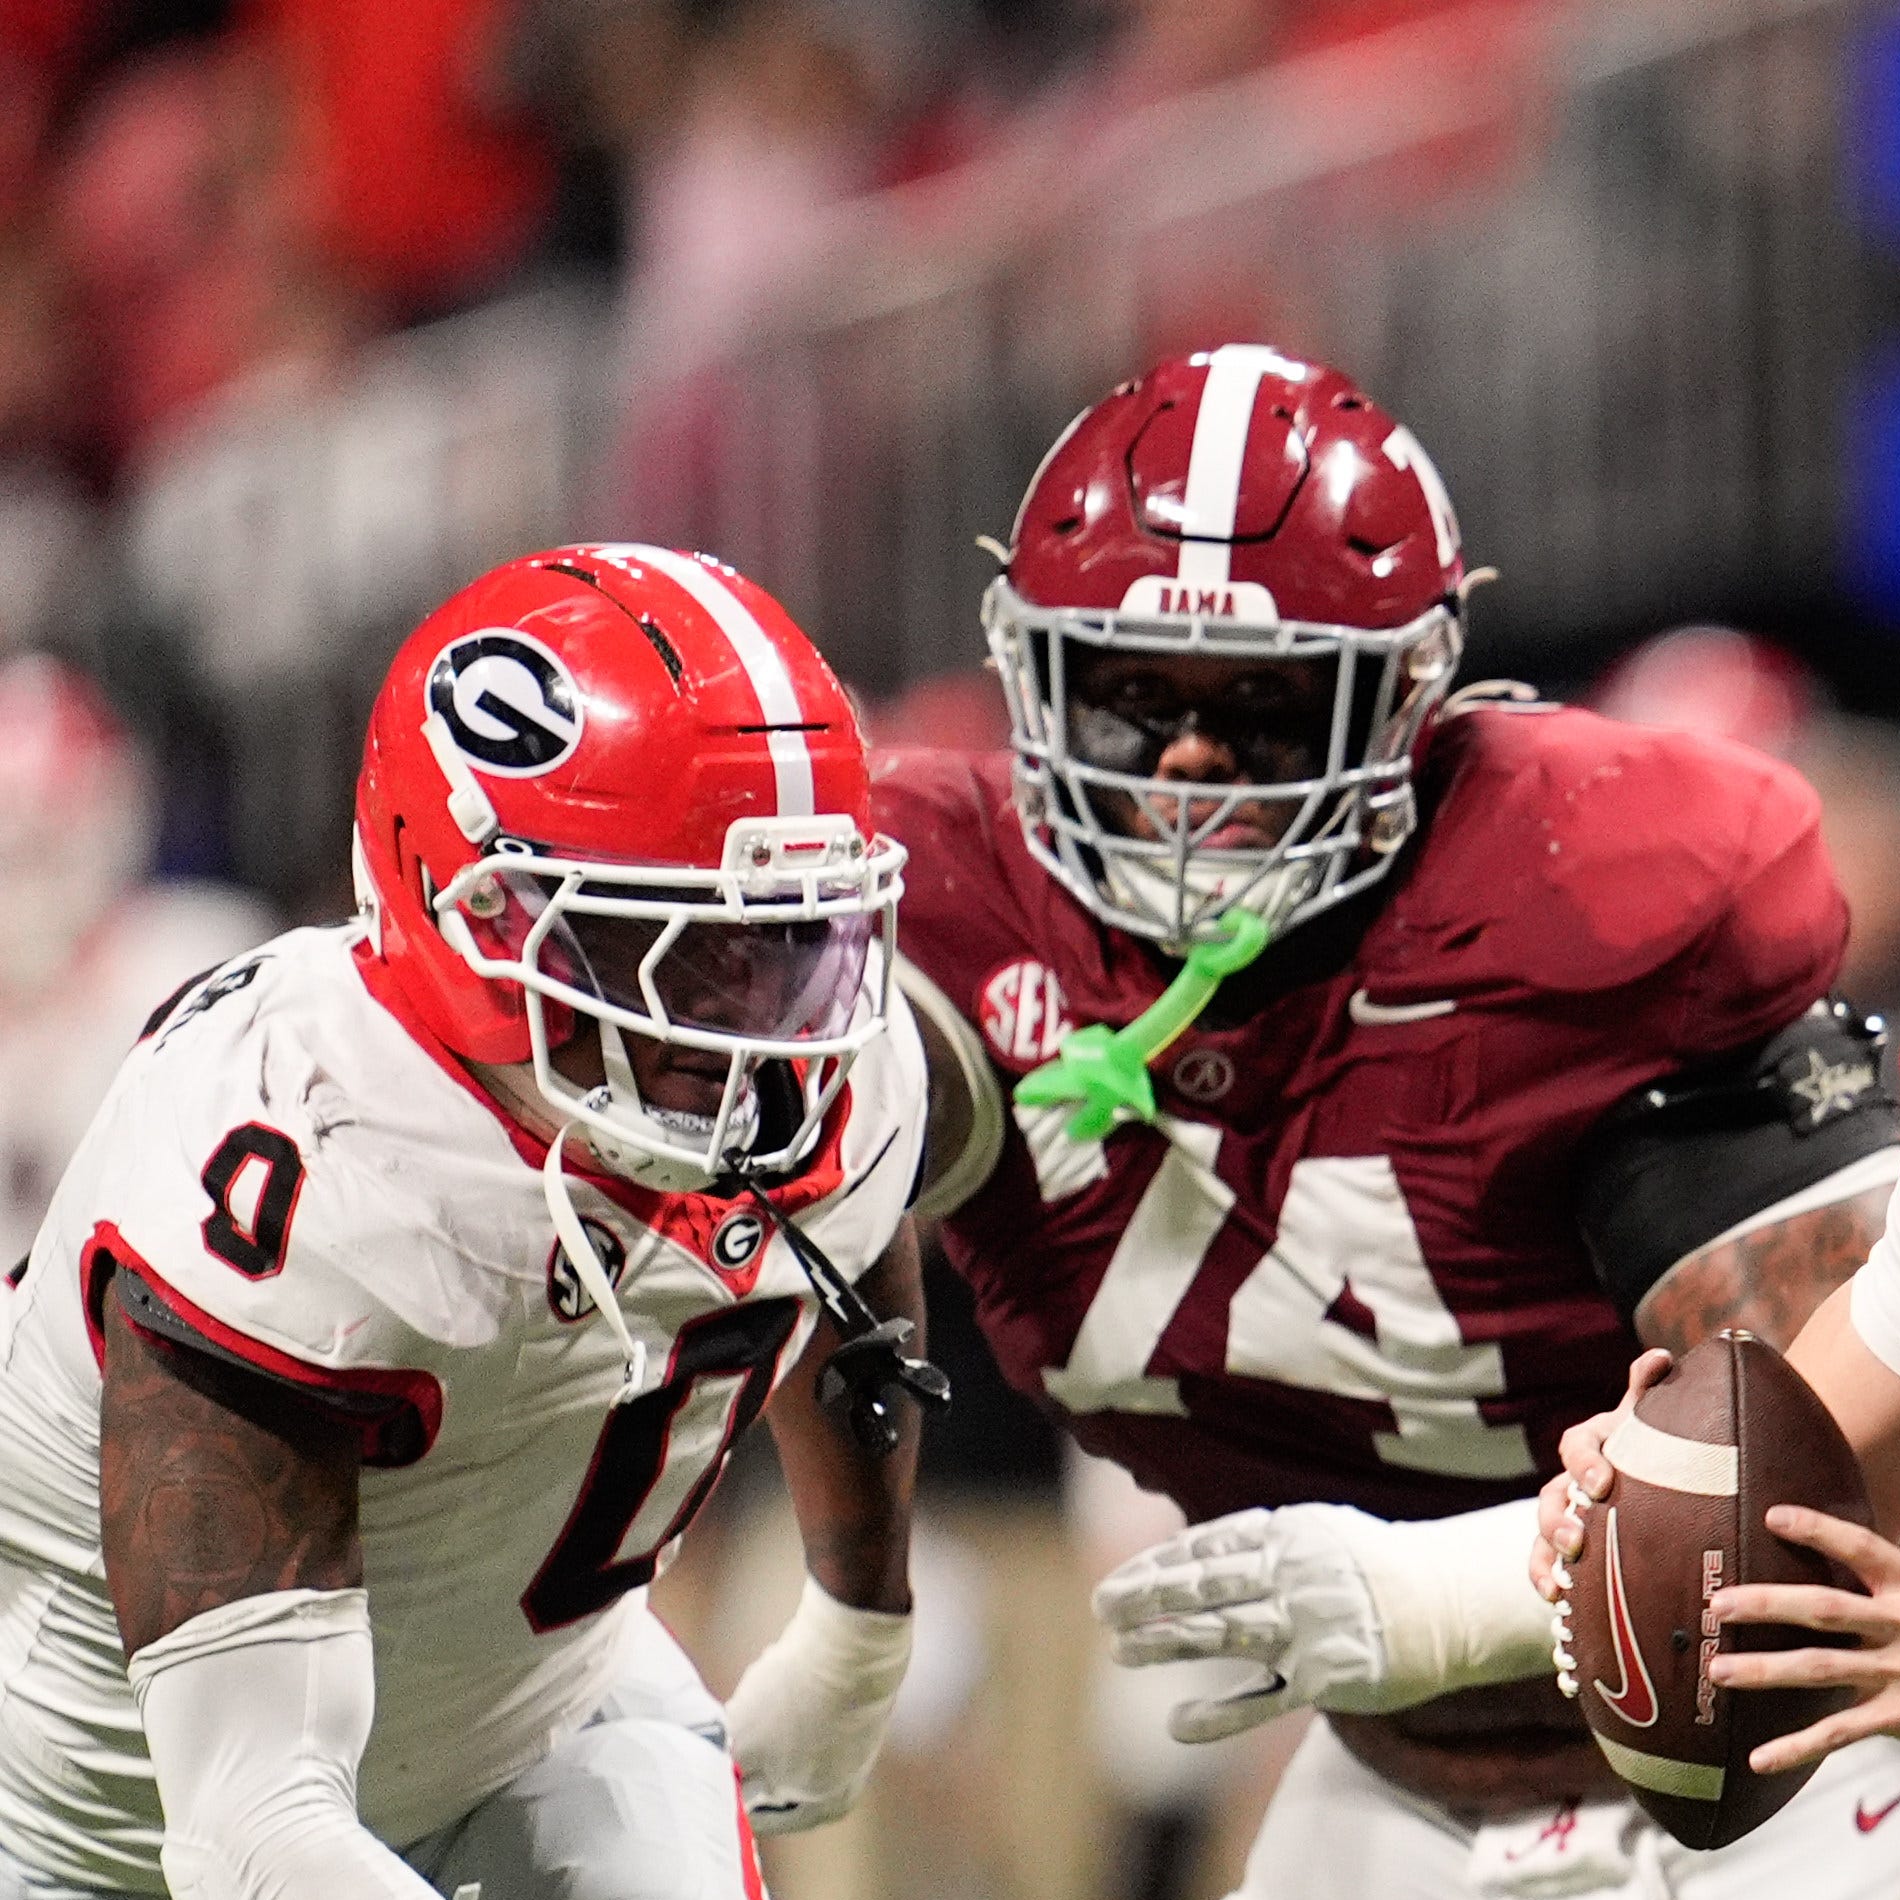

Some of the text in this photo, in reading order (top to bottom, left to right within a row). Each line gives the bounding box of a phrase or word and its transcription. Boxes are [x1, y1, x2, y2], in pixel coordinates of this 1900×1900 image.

[429, 635, 579, 770] G
[200, 1120, 306, 1282] 0
[714, 1213, 761, 1265] G
[1013, 1102, 1538, 1482] 74
[521, 1298, 806, 1634] 0
